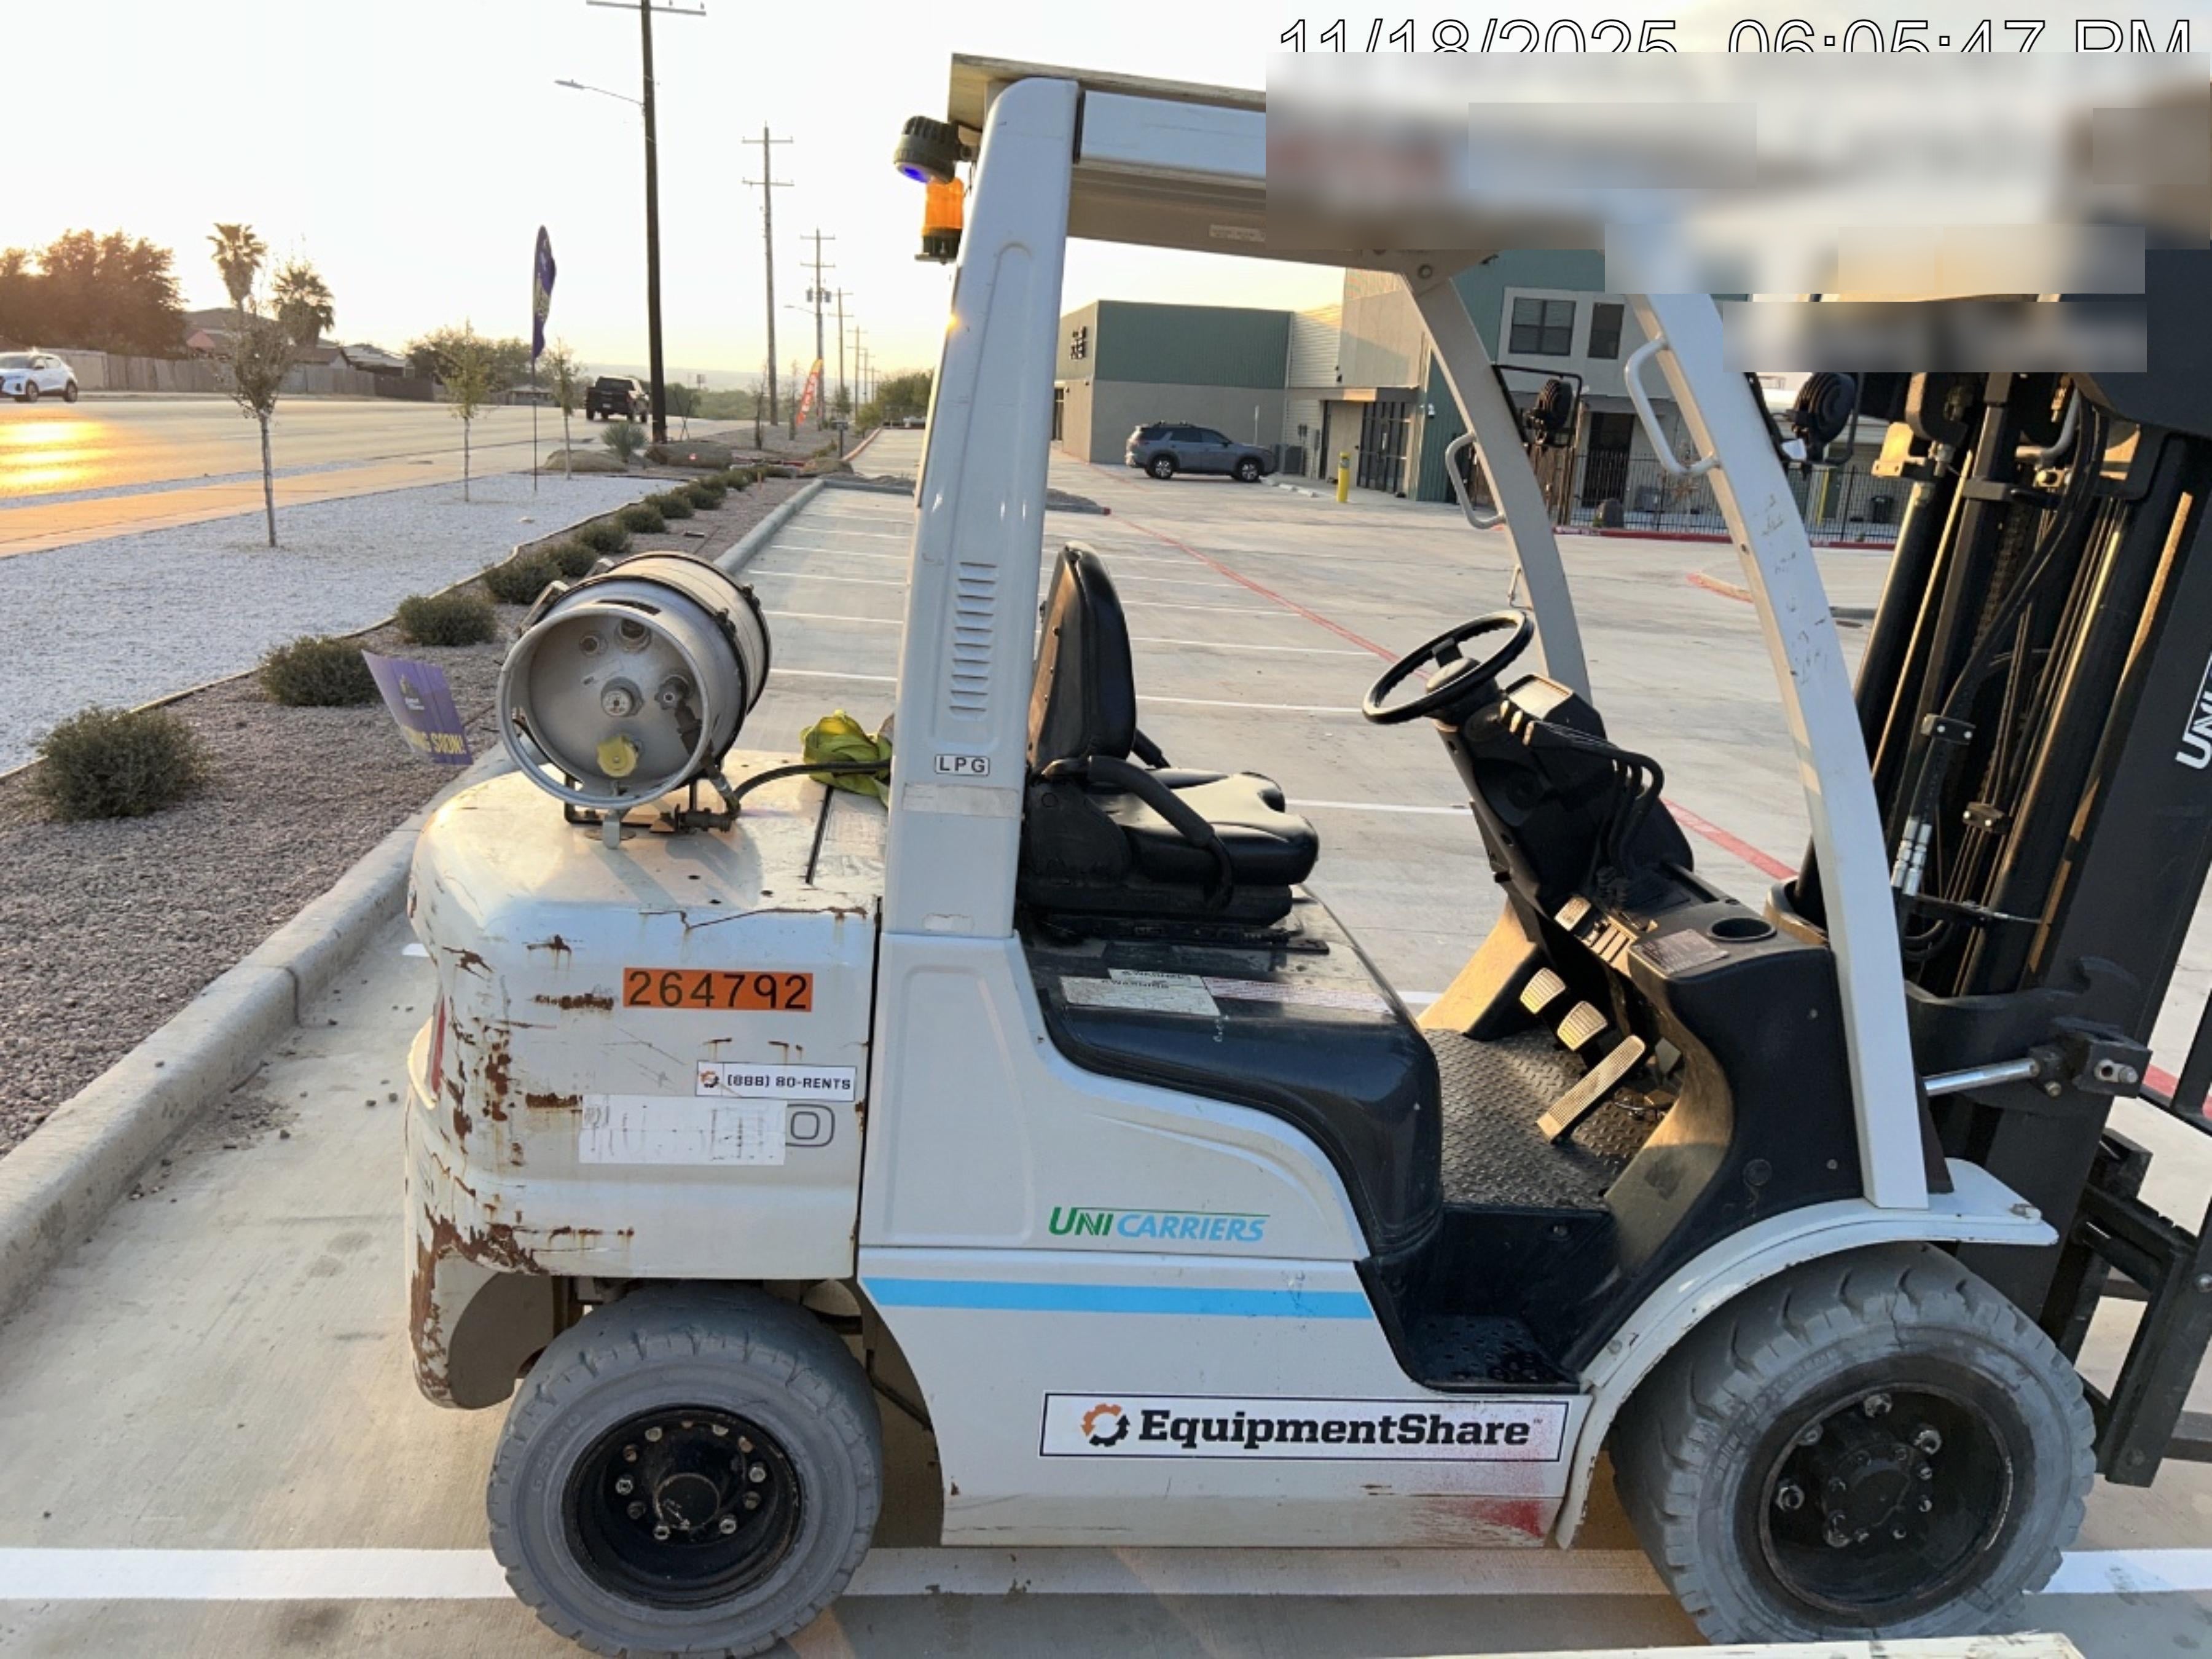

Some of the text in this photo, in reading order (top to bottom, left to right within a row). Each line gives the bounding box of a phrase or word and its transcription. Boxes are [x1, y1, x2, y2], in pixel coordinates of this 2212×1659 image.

[939, 756, 985, 773] LPG
[628, 970, 807, 1010] 264792
[775, 1076, 852, 1090] 80-RENTS
